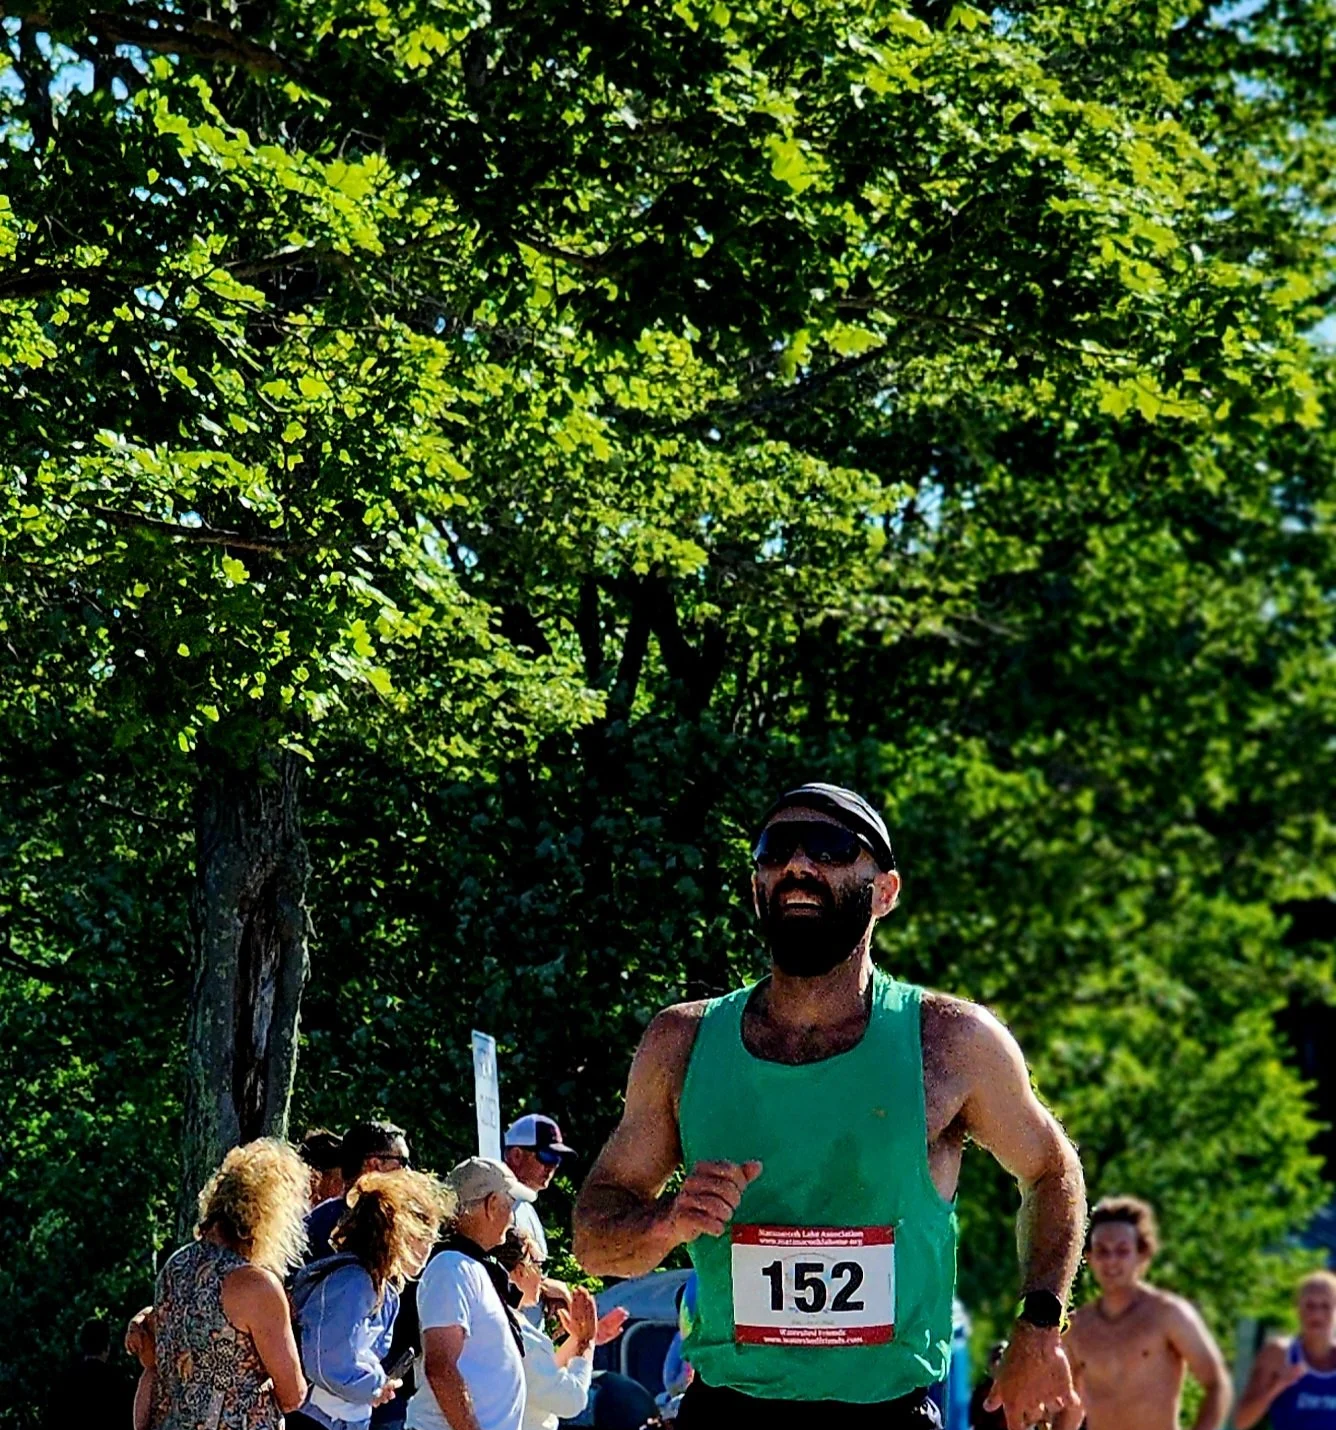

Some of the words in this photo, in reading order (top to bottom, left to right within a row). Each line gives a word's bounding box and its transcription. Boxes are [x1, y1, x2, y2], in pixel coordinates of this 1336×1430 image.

[802, 1230, 820, 1238] Lake
[821, 1229, 864, 1238] Association
[762, 1260, 864, 1313] 152
